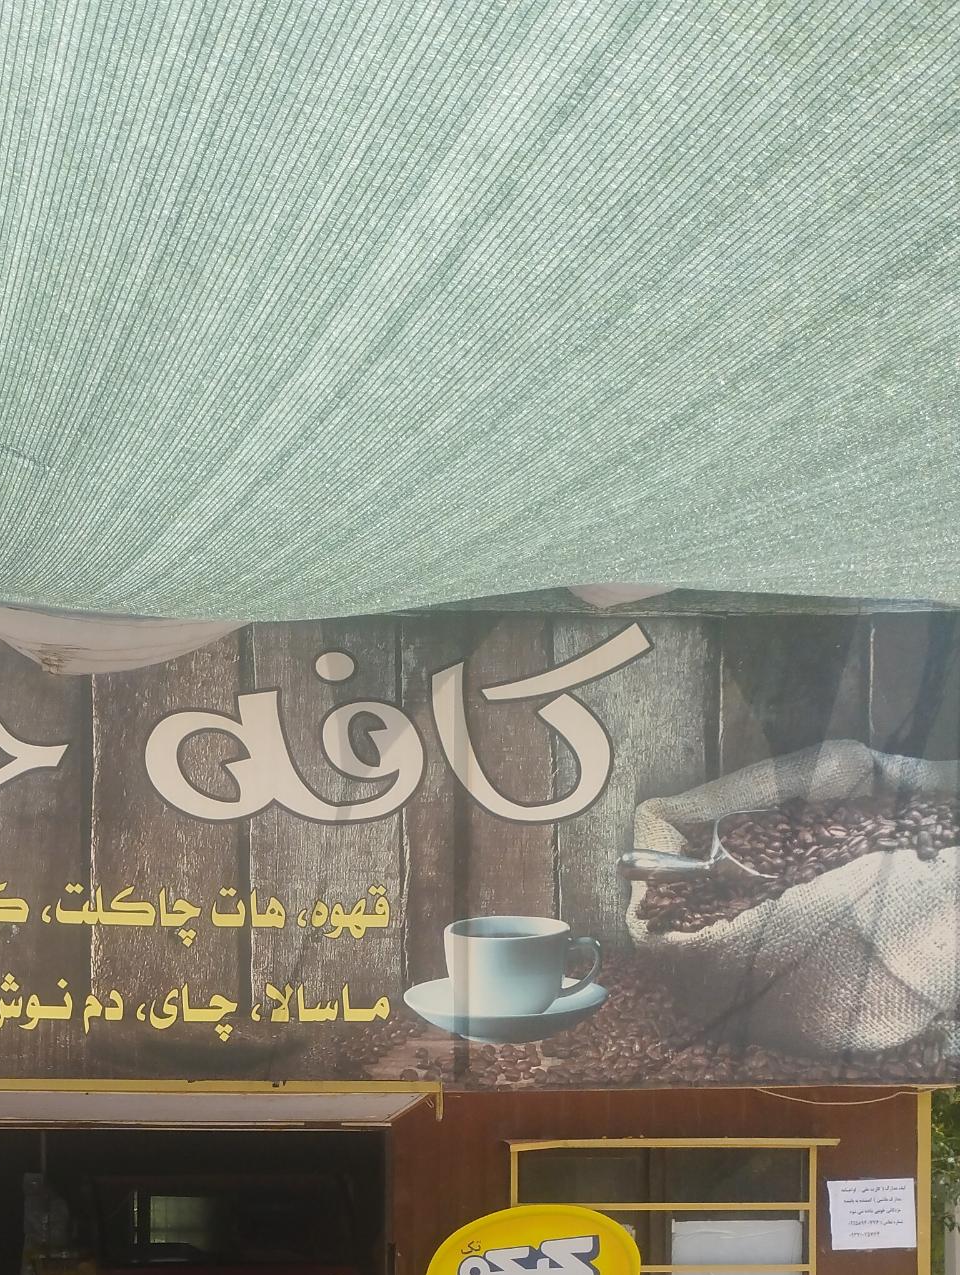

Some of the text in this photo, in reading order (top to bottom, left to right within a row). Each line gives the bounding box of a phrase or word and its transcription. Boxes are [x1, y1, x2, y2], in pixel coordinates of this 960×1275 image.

[143, 621, 655, 825] کافه
[41, 881, 202, 948] چاکلت،
[210, 884, 287, 929] هات
[297, 883, 391, 939] قهوه،
[82, 987, 125, 1035] دم
[135, 982, 239, 1043] چای،
